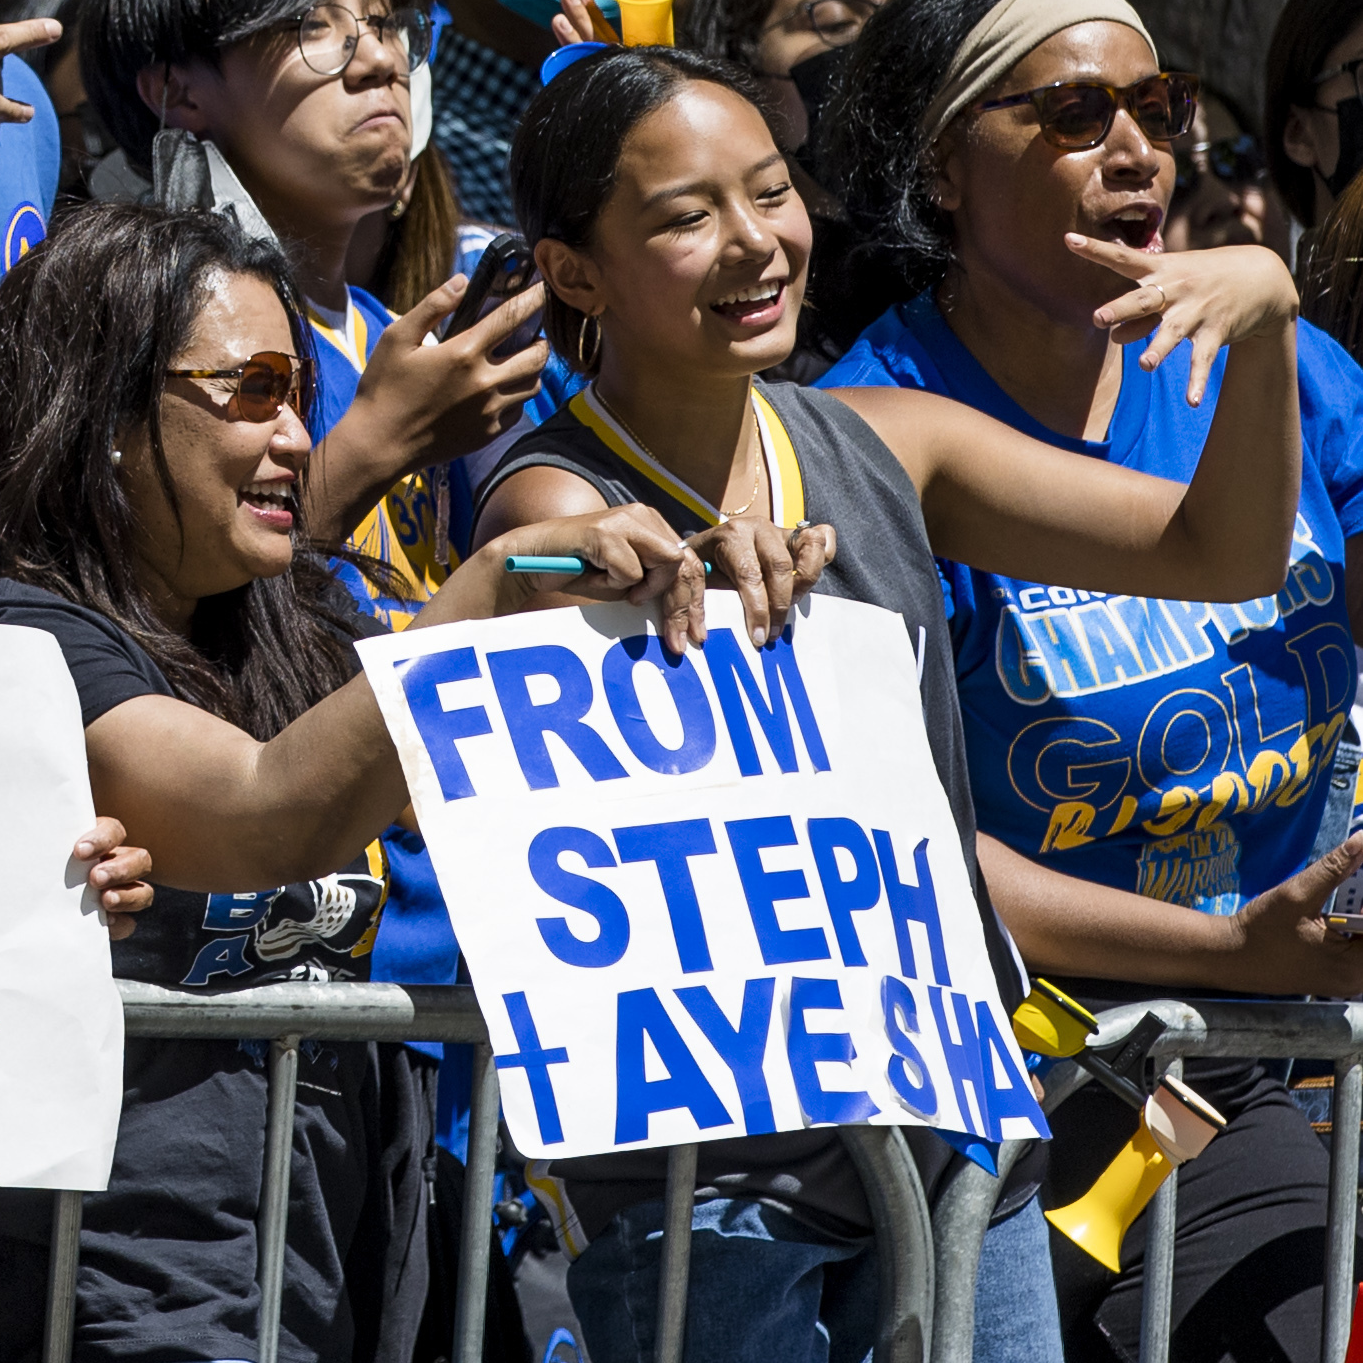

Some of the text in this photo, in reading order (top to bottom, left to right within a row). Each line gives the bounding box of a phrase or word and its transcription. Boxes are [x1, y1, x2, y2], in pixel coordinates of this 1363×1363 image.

[393, 623, 832, 803] FROM
[1007, 622, 1350, 813] GOLD
[527, 814, 952, 987] STEPH
